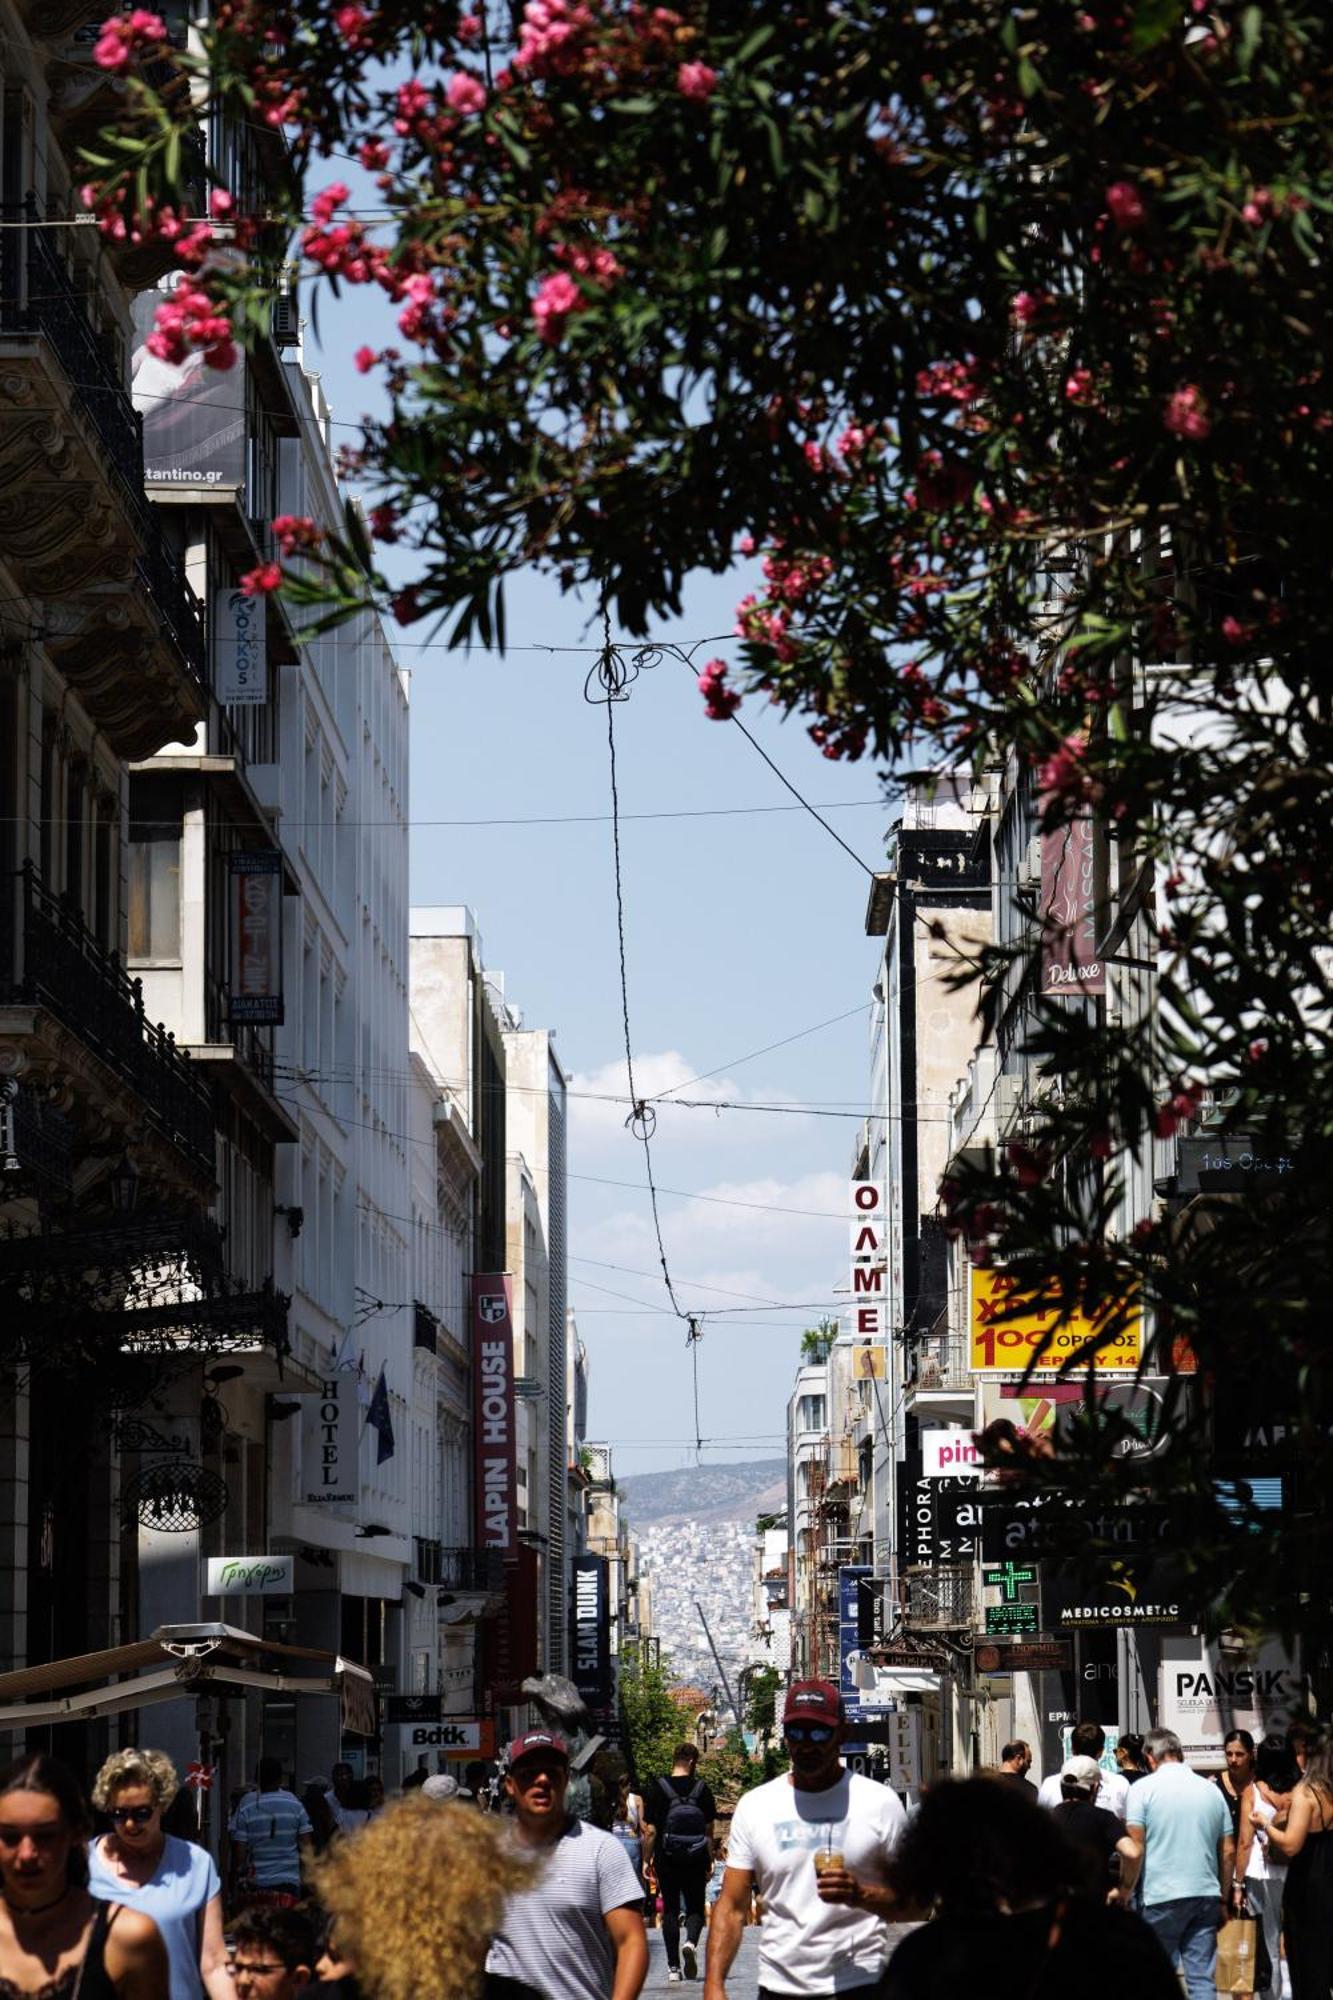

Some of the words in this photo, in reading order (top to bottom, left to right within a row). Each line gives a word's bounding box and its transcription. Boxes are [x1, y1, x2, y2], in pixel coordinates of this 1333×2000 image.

[1114, 1356, 1137, 1366] 14
[482, 1342, 507, 1444] HOUSE
[321, 1381, 339, 1485] HOTEL
[484, 1458, 510, 1548] LAPIN
[917, 1478, 933, 1576] EPHORA
[577, 1570, 598, 1620] DUNK
[1061, 1604, 1179, 1619] MEDICOSMETIC
[577, 1624, 598, 1671] SLAM
[1177, 1670, 1285, 1697] PANSIK
